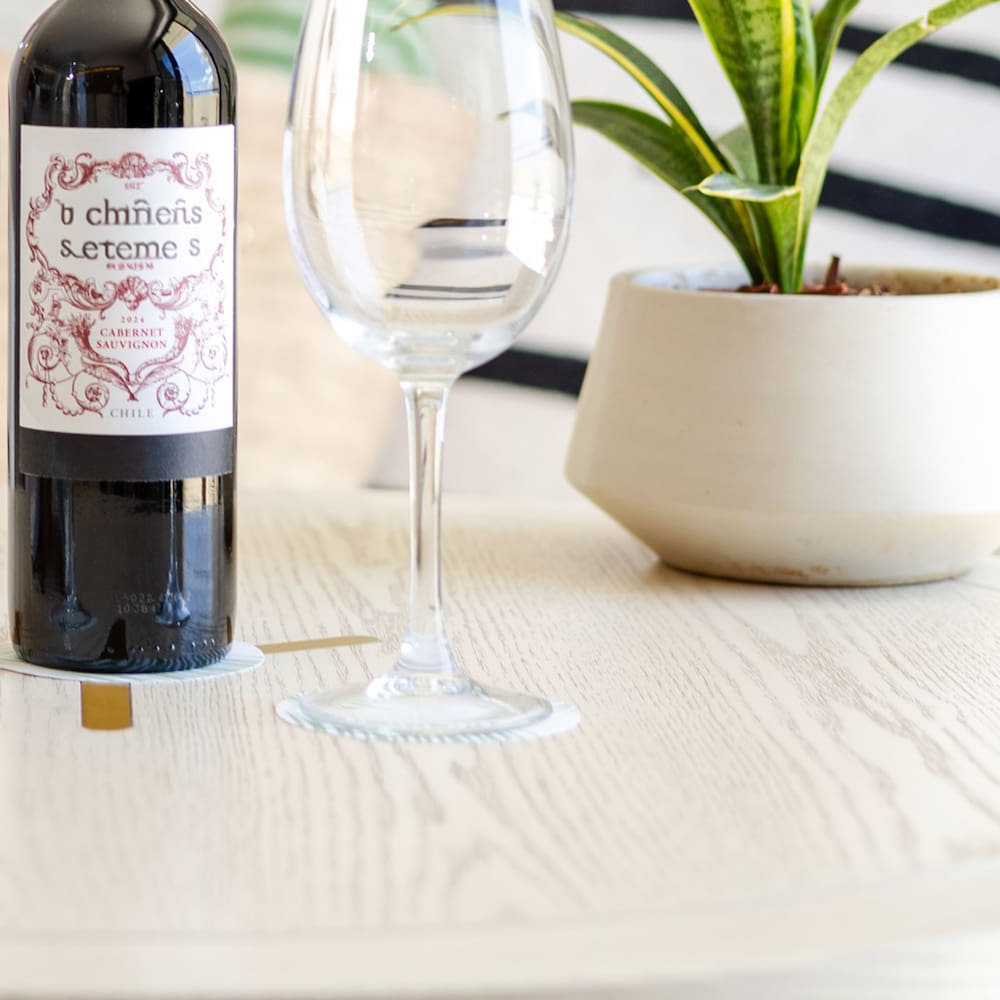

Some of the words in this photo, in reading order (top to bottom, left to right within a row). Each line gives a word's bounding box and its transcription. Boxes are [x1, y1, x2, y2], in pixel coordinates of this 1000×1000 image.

[121, 315, 145, 323] 2024
[100, 327, 164, 337] CABERNET
[96, 340, 167, 349] SAUVIGNON
[110, 407, 153, 418] CHILE
